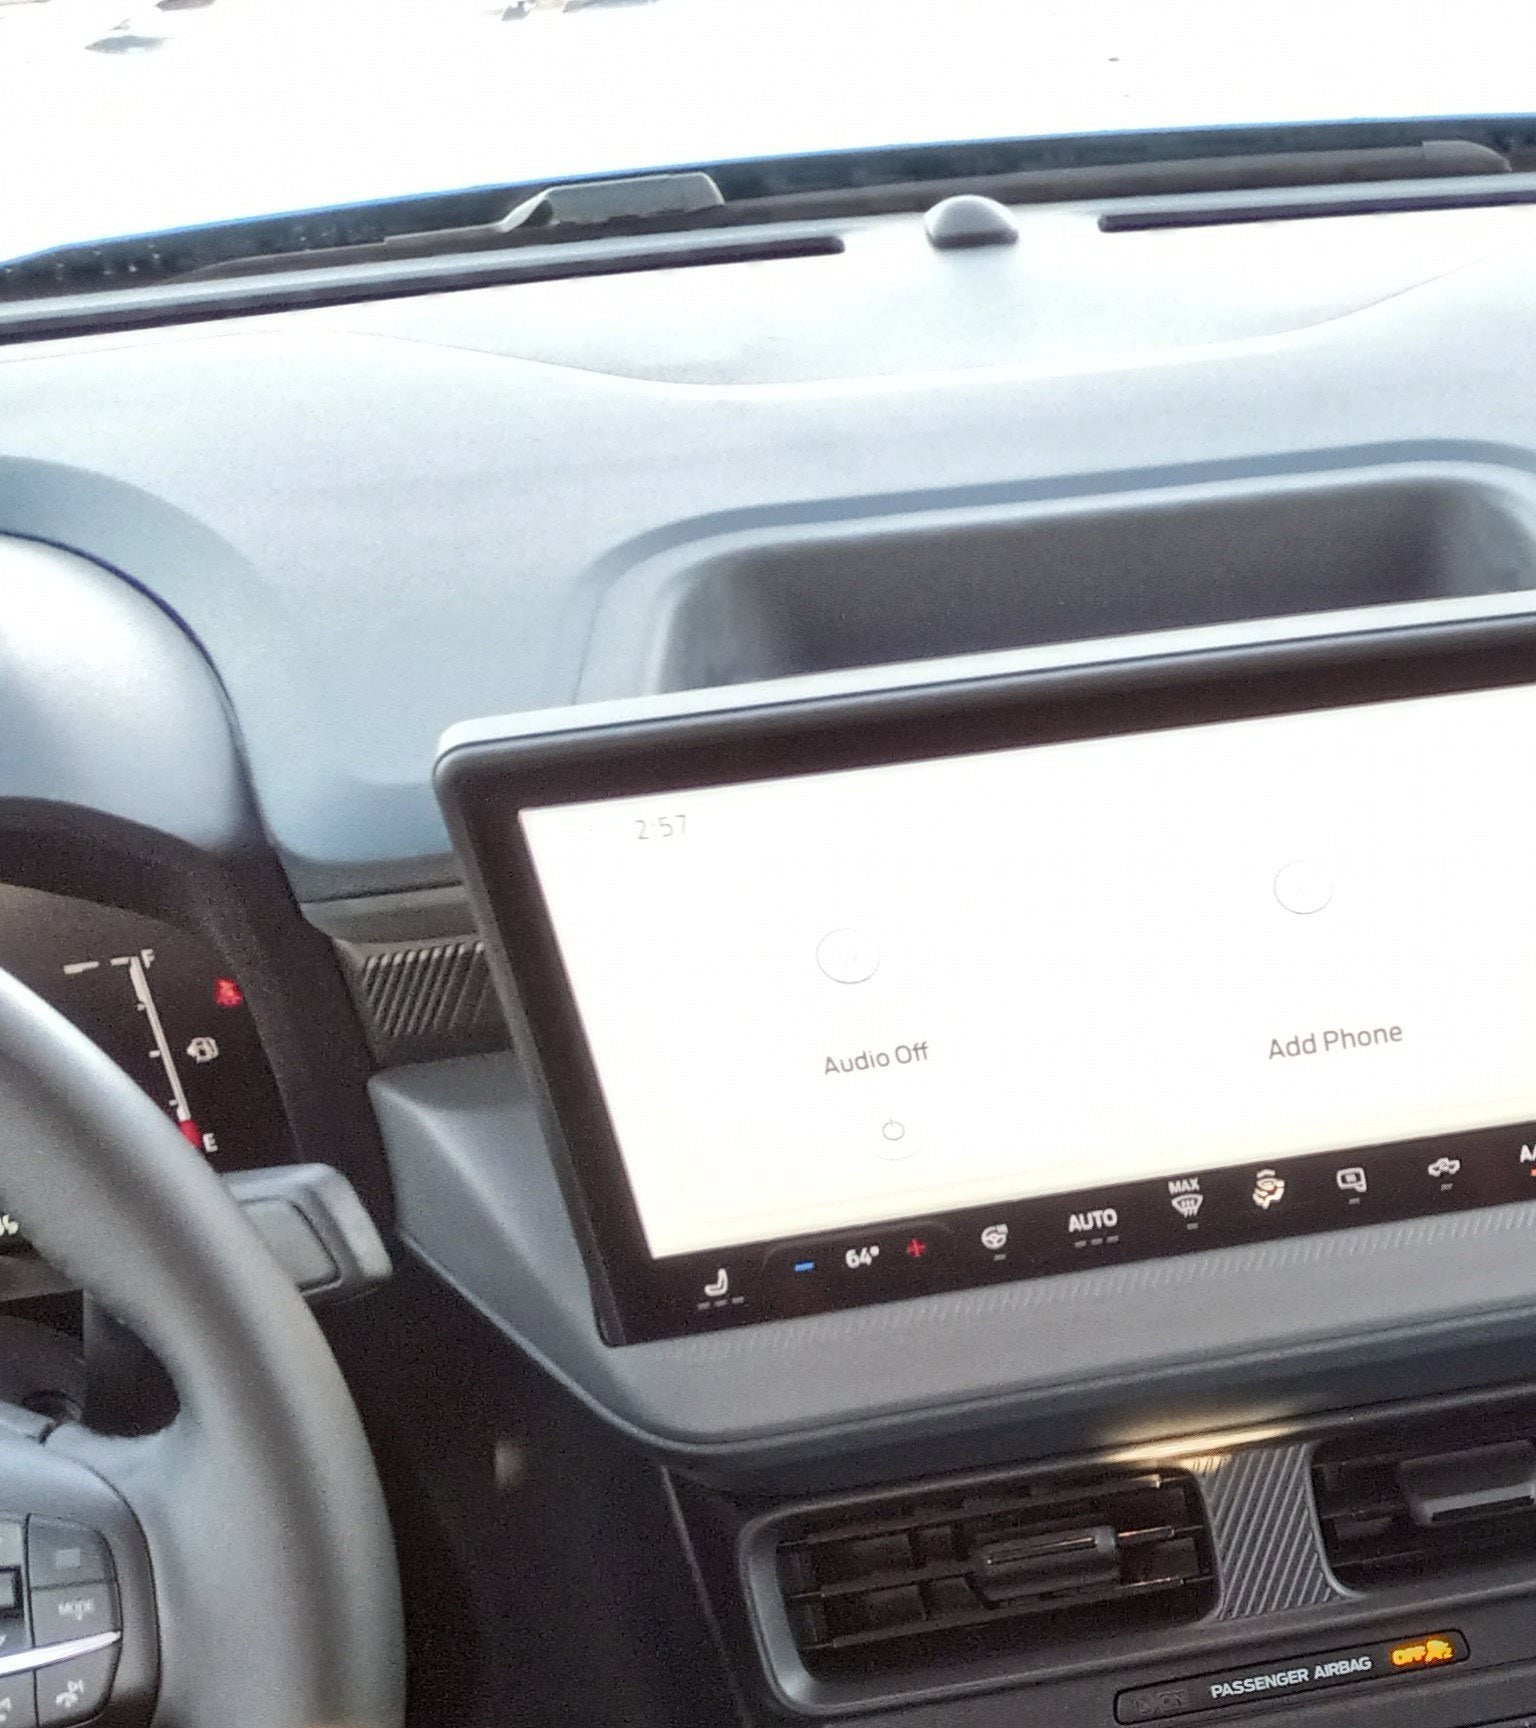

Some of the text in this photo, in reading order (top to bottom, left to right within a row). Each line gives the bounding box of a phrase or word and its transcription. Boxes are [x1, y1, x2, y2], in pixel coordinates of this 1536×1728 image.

[634, 815, 688, 841] 2:57
[1267, 1021, 1404, 1060] Add Phone
[823, 1041, 930, 1075] Audio Off
[203, 1132, 218, 1152] E
[1168, 1179, 1201, 1196] MAX
[1067, 1208, 1119, 1233] AUTO
[1210, 1656, 1373, 1699] PASSENGER AIRBAG
